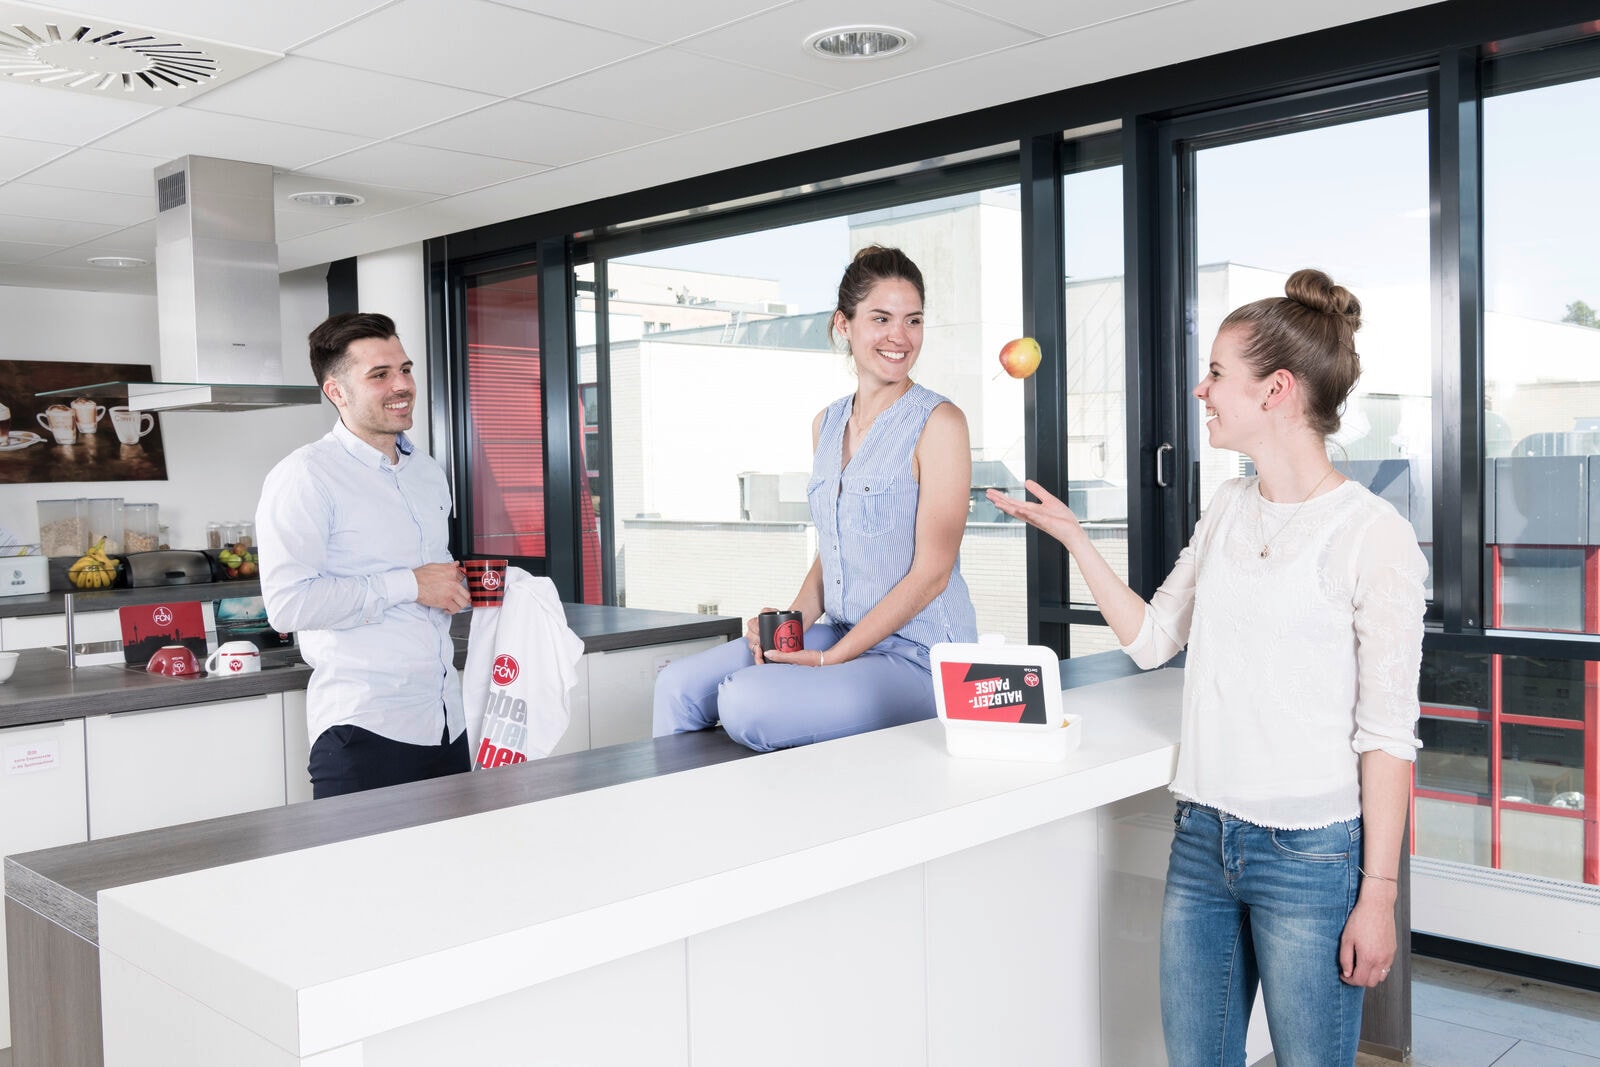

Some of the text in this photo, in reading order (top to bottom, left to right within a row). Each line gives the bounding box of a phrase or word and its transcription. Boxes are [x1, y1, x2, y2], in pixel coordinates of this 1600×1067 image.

[483, 578, 499, 586] FCN
[155, 614, 171, 622] FCN
[493, 664, 516, 679] FCN
[974, 678, 1010, 695] PAUSE
[968, 690, 1023, 709] HALBZEIT-
